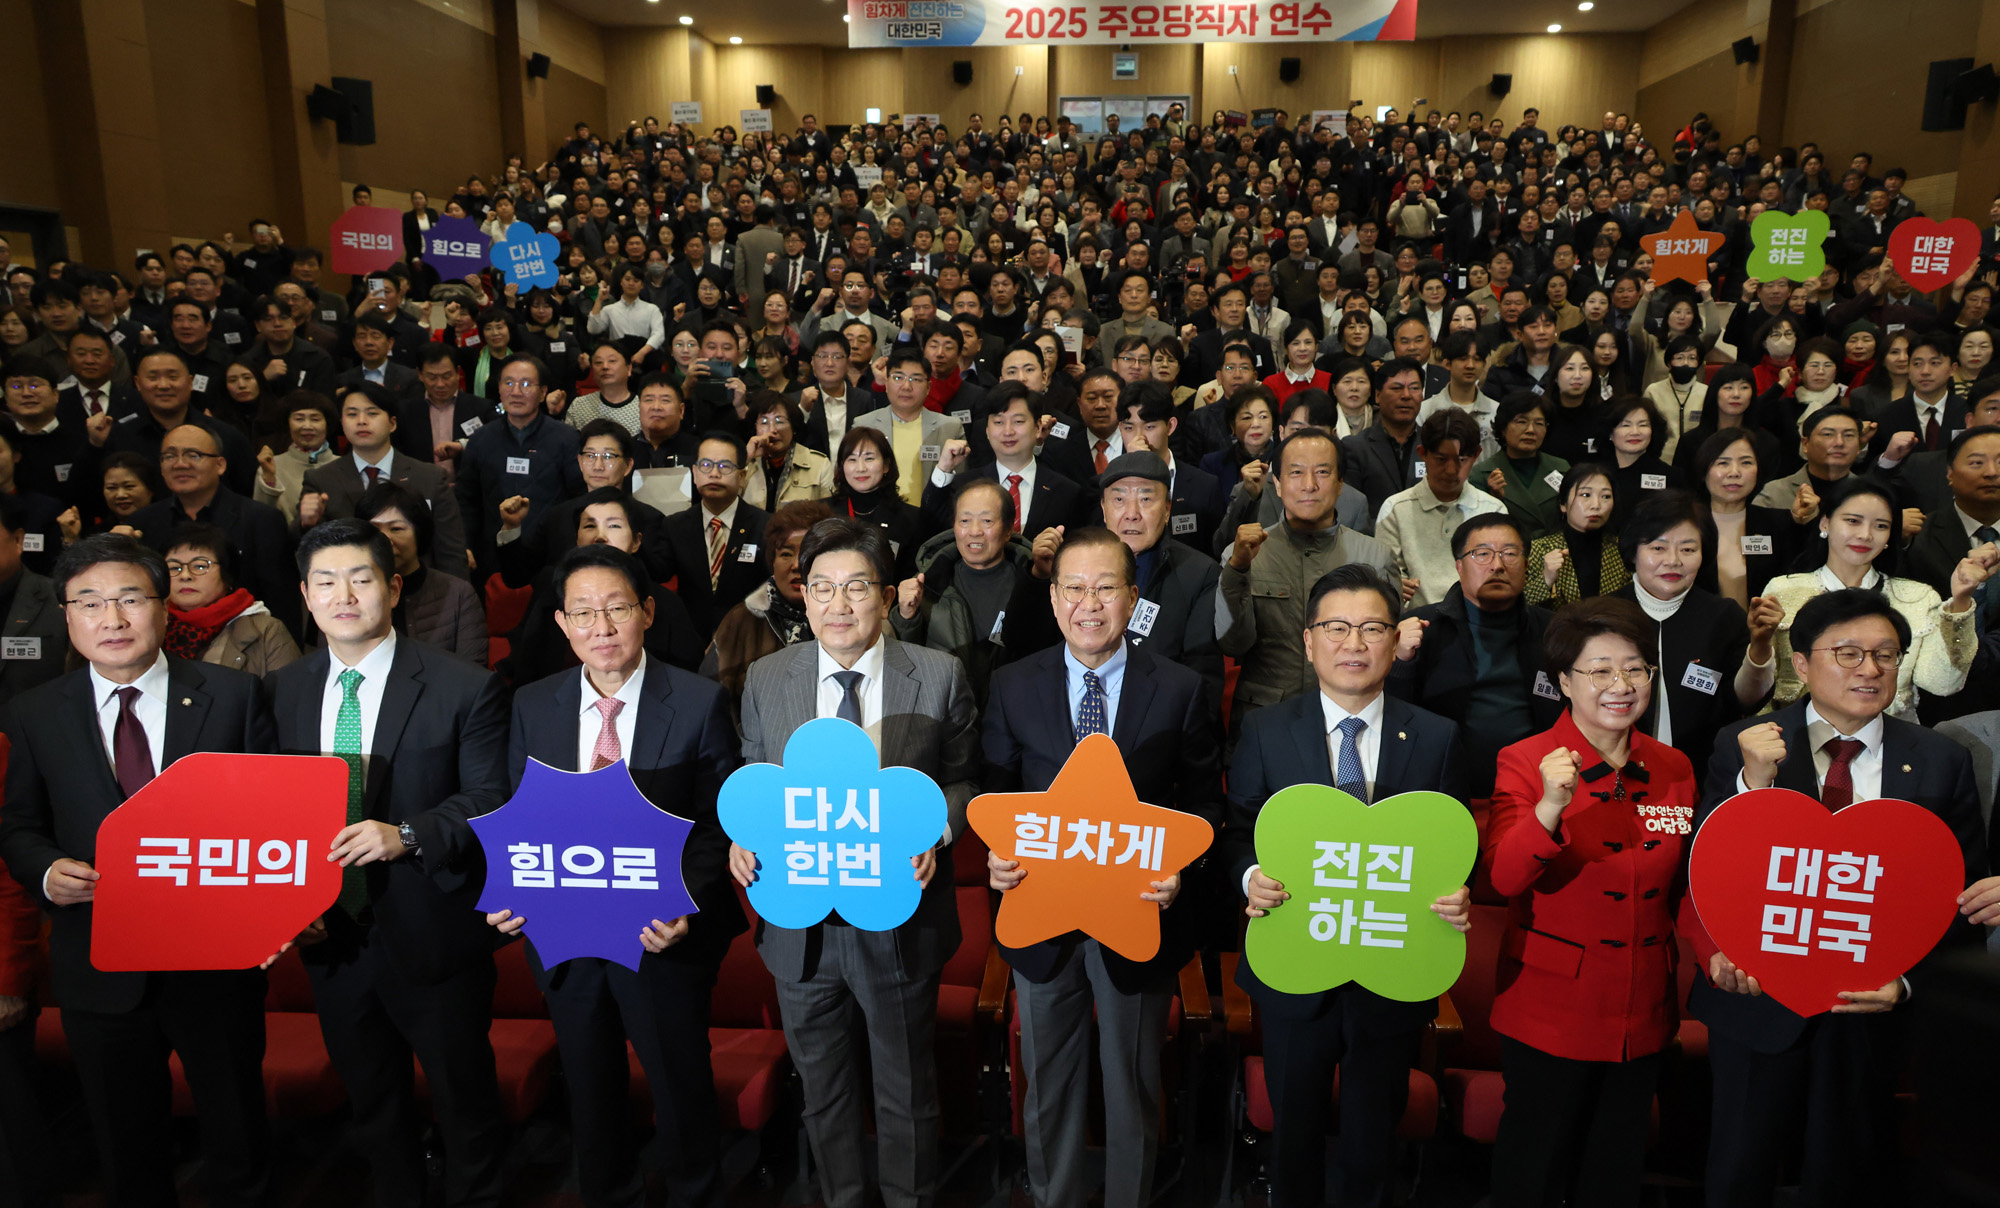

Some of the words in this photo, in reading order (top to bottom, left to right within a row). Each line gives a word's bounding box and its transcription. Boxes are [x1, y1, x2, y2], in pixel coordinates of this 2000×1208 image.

[865, 3, 905, 18] 힘차게
[909, 2, 963, 17] 전진하는
[1005, 7, 1088, 38] 2025
[1098, 4, 1259, 38] 주요당직자
[1269, 2, 1333, 36] 연수
[887, 21, 942, 39] 대한민국
[341, 231, 393, 251] 국민의
[1655, 237, 1709, 256] 힘차게
[1770, 228, 1808, 246] 전진
[1913, 235, 1955, 254] 대한
[432, 239, 482, 259] 힘으로
[508, 240, 542, 262] 다시
[1768, 247, 1805, 265] 하는
[513, 258, 547, 280] 한번
[1910, 255, 1950, 275] 민국
[1687, 675, 1714, 691] 정명희
[783, 786, 880, 834] 다시
[1636, 804, 1694, 818] 중앙연수원장
[1645, 817, 1692, 835] 이달희
[1013, 811, 1166, 872] 힘차게
[135, 837, 308, 887] 국민의
[506, 841, 660, 890] 힘으로
[783, 840, 882, 888] 한번
[1311, 840, 1414, 893] 전진
[1765, 845, 1884, 904] 대한
[1307, 897, 1408, 949] 하는
[1760, 903, 1872, 963] 민국
